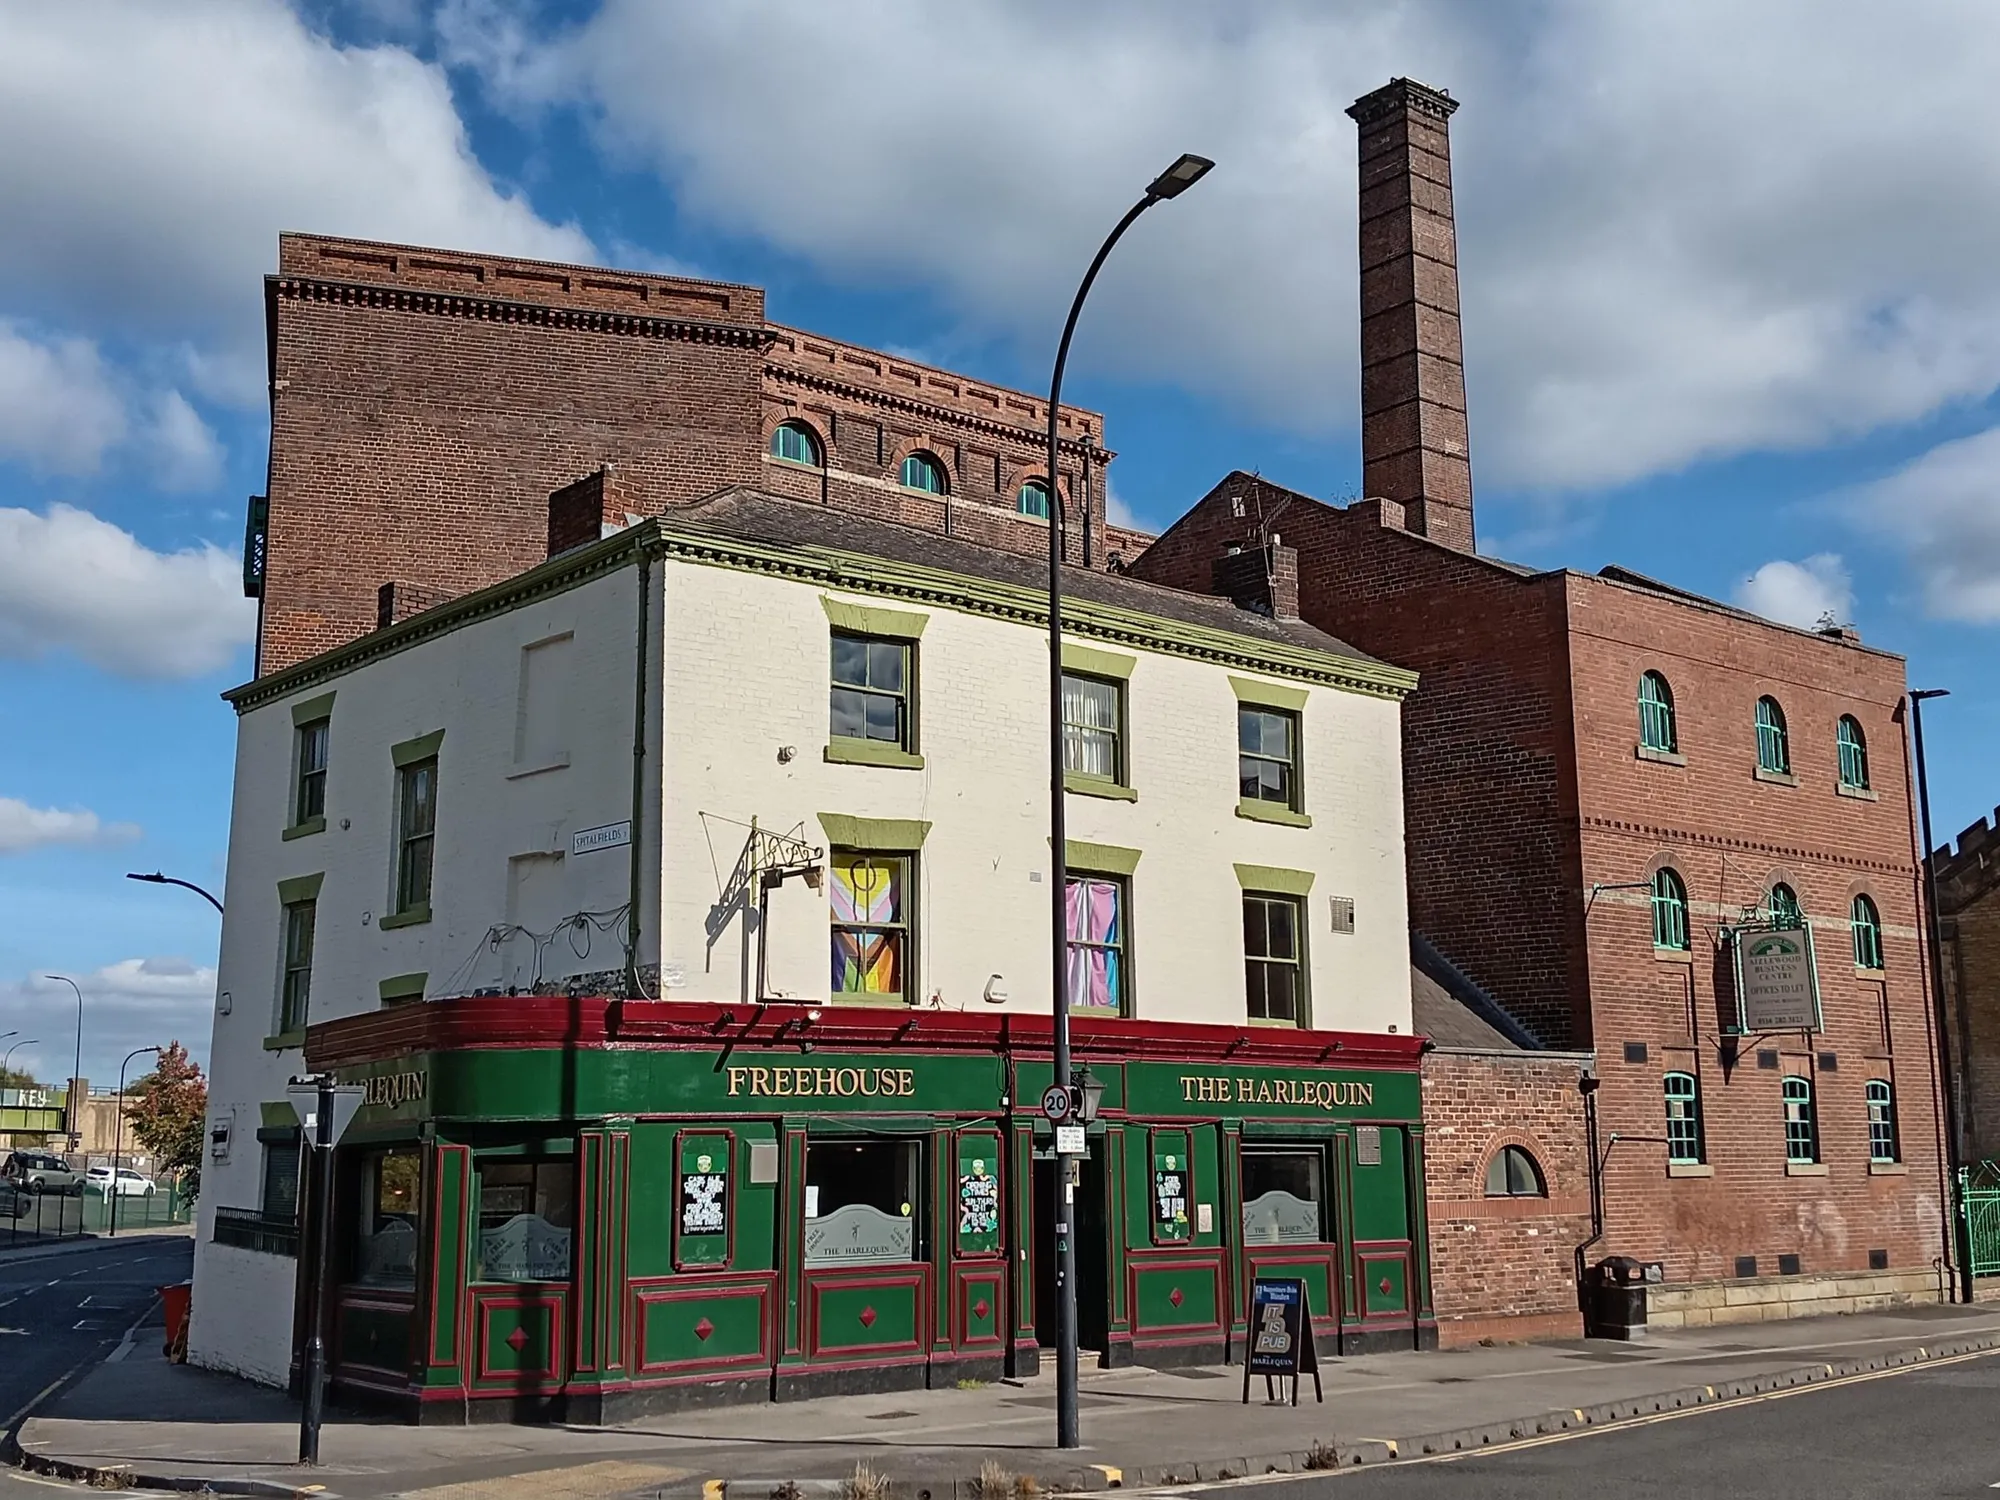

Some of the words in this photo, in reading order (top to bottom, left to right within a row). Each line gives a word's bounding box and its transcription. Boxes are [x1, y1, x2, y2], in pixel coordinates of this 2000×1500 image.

[575, 828, 621, 848] SPITALFIELDS
[1749, 955, 1802, 965] AIZLEWOOD
[1754, 963, 1797, 973] BUSINESS
[1758, 972, 1793, 980] CENTRE
[1750, 985, 1779, 995] OFFICES
[1781, 984, 1791, 993] TO
[1791, 983, 1804, 993] LET
[726, 1066, 916, 1097] FREEHOUSE
[1179, 1076, 1232, 1103] THE
[1235, 1077, 1373, 1111] HARLEQUIN
[1046, 1094, 1067, 1112] 20
[966, 1181, 992, 1190] OPENING
[971, 1188, 989, 1196] TIMES
[806, 1228, 820, 1245] FREE
[824, 1247, 839, 1256] THE
[845, 1245, 890, 1256] HARLEQUIN
[1267, 1306, 1279, 1318] IT
[1269, 1321, 1280, 1333] IS
[1260, 1336, 1286, 1349] PUB
[1252, 1358, 1293, 1367] HARLEQUIN
